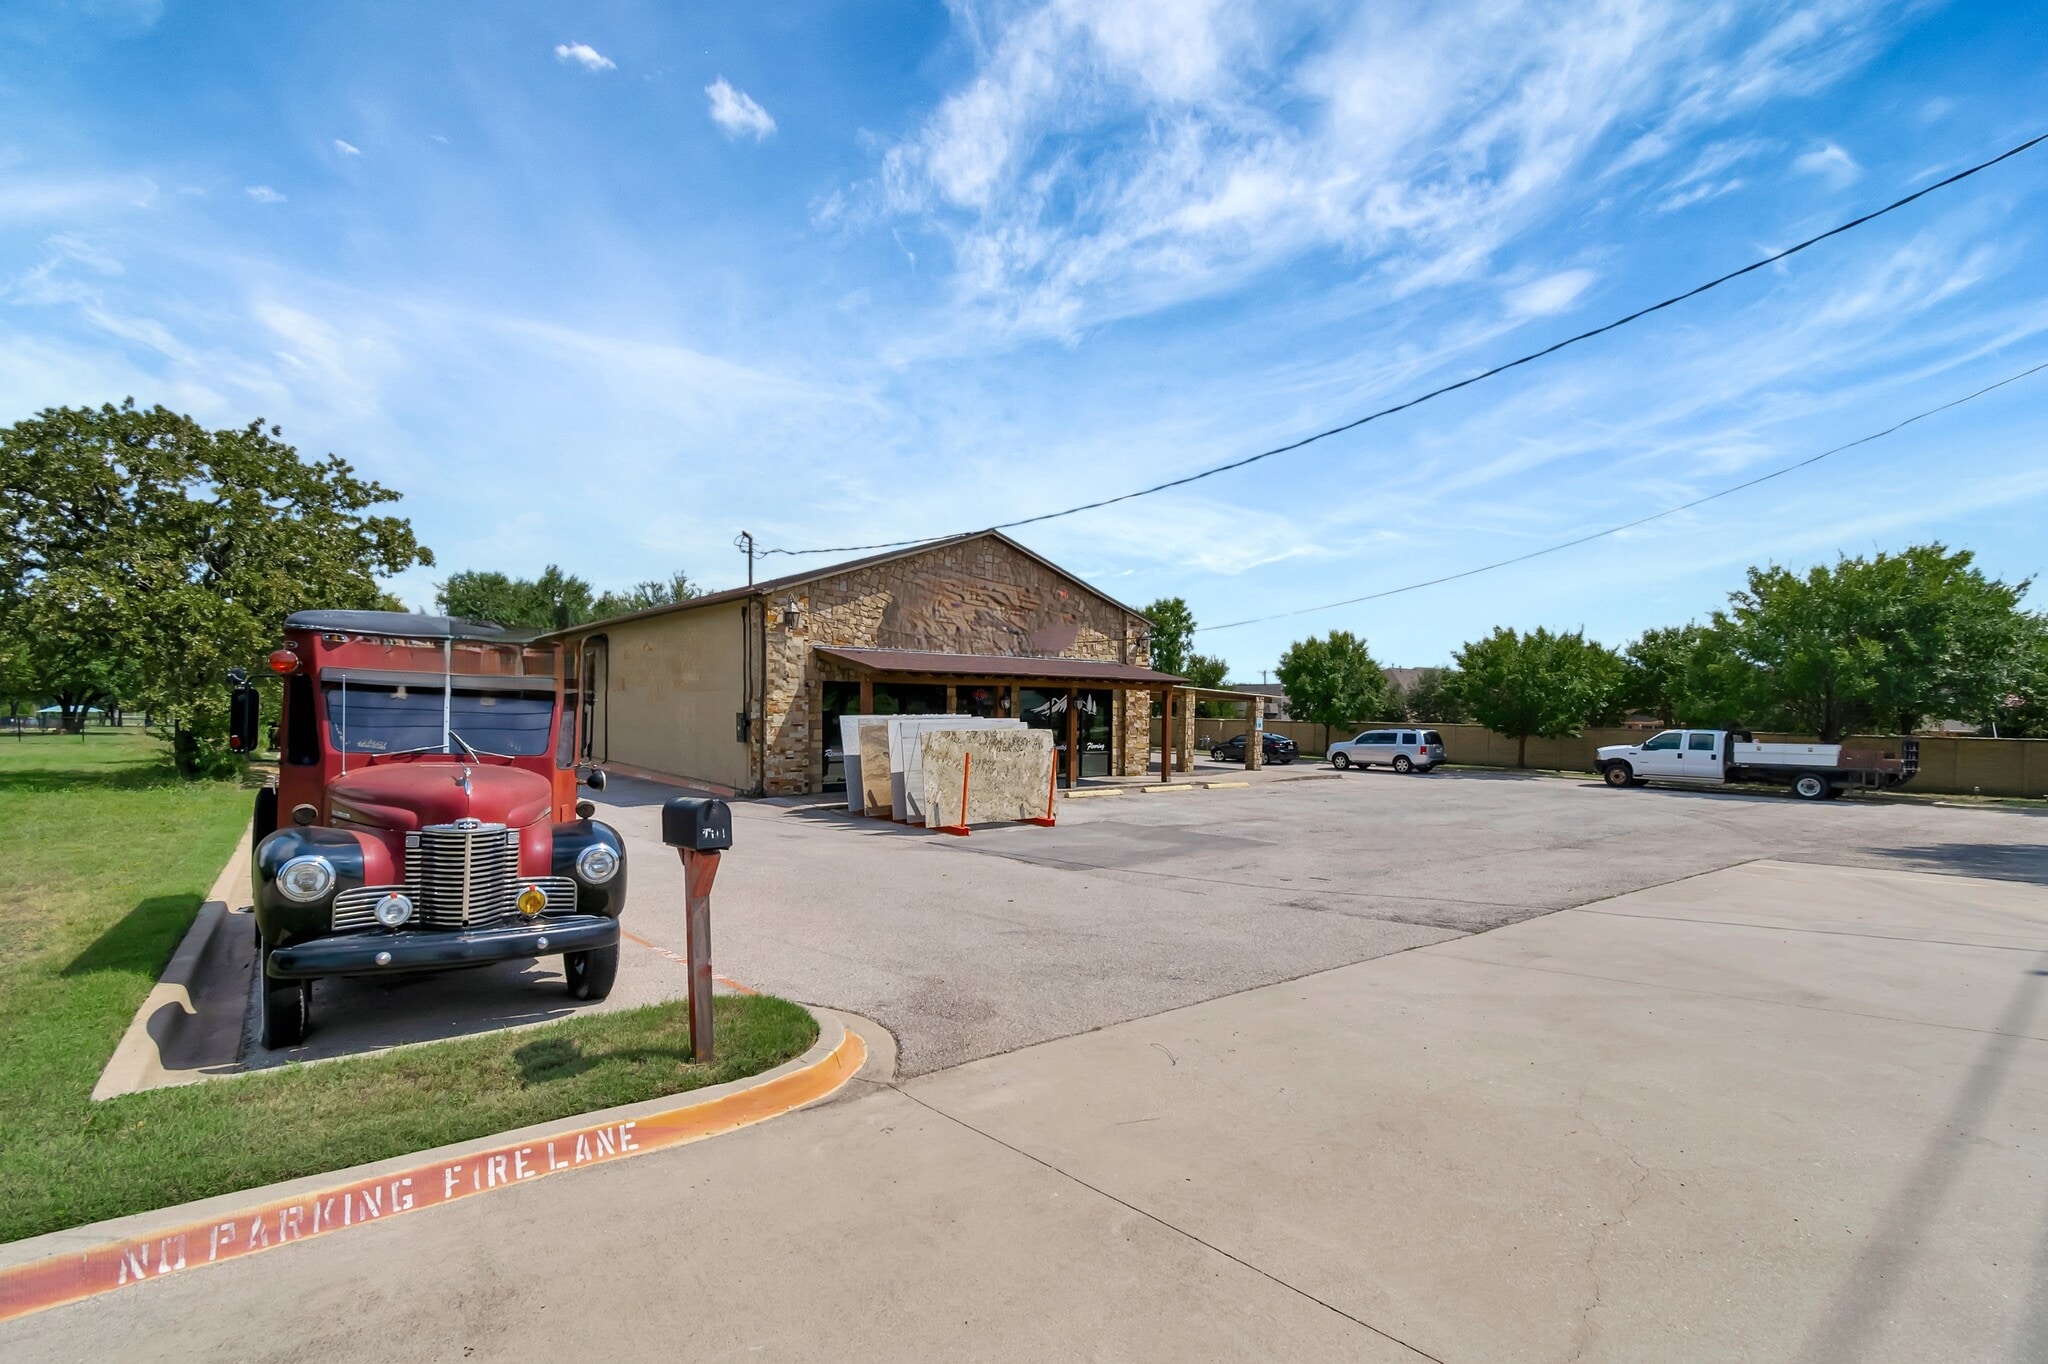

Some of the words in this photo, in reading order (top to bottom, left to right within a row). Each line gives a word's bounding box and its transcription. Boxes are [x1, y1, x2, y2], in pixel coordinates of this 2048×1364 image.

[117, 1234, 186, 1285] NO
[208, 1178, 413, 1262] PARKING
[444, 1148, 536, 1199] FIRE
[547, 1121, 640, 1171] LANE
